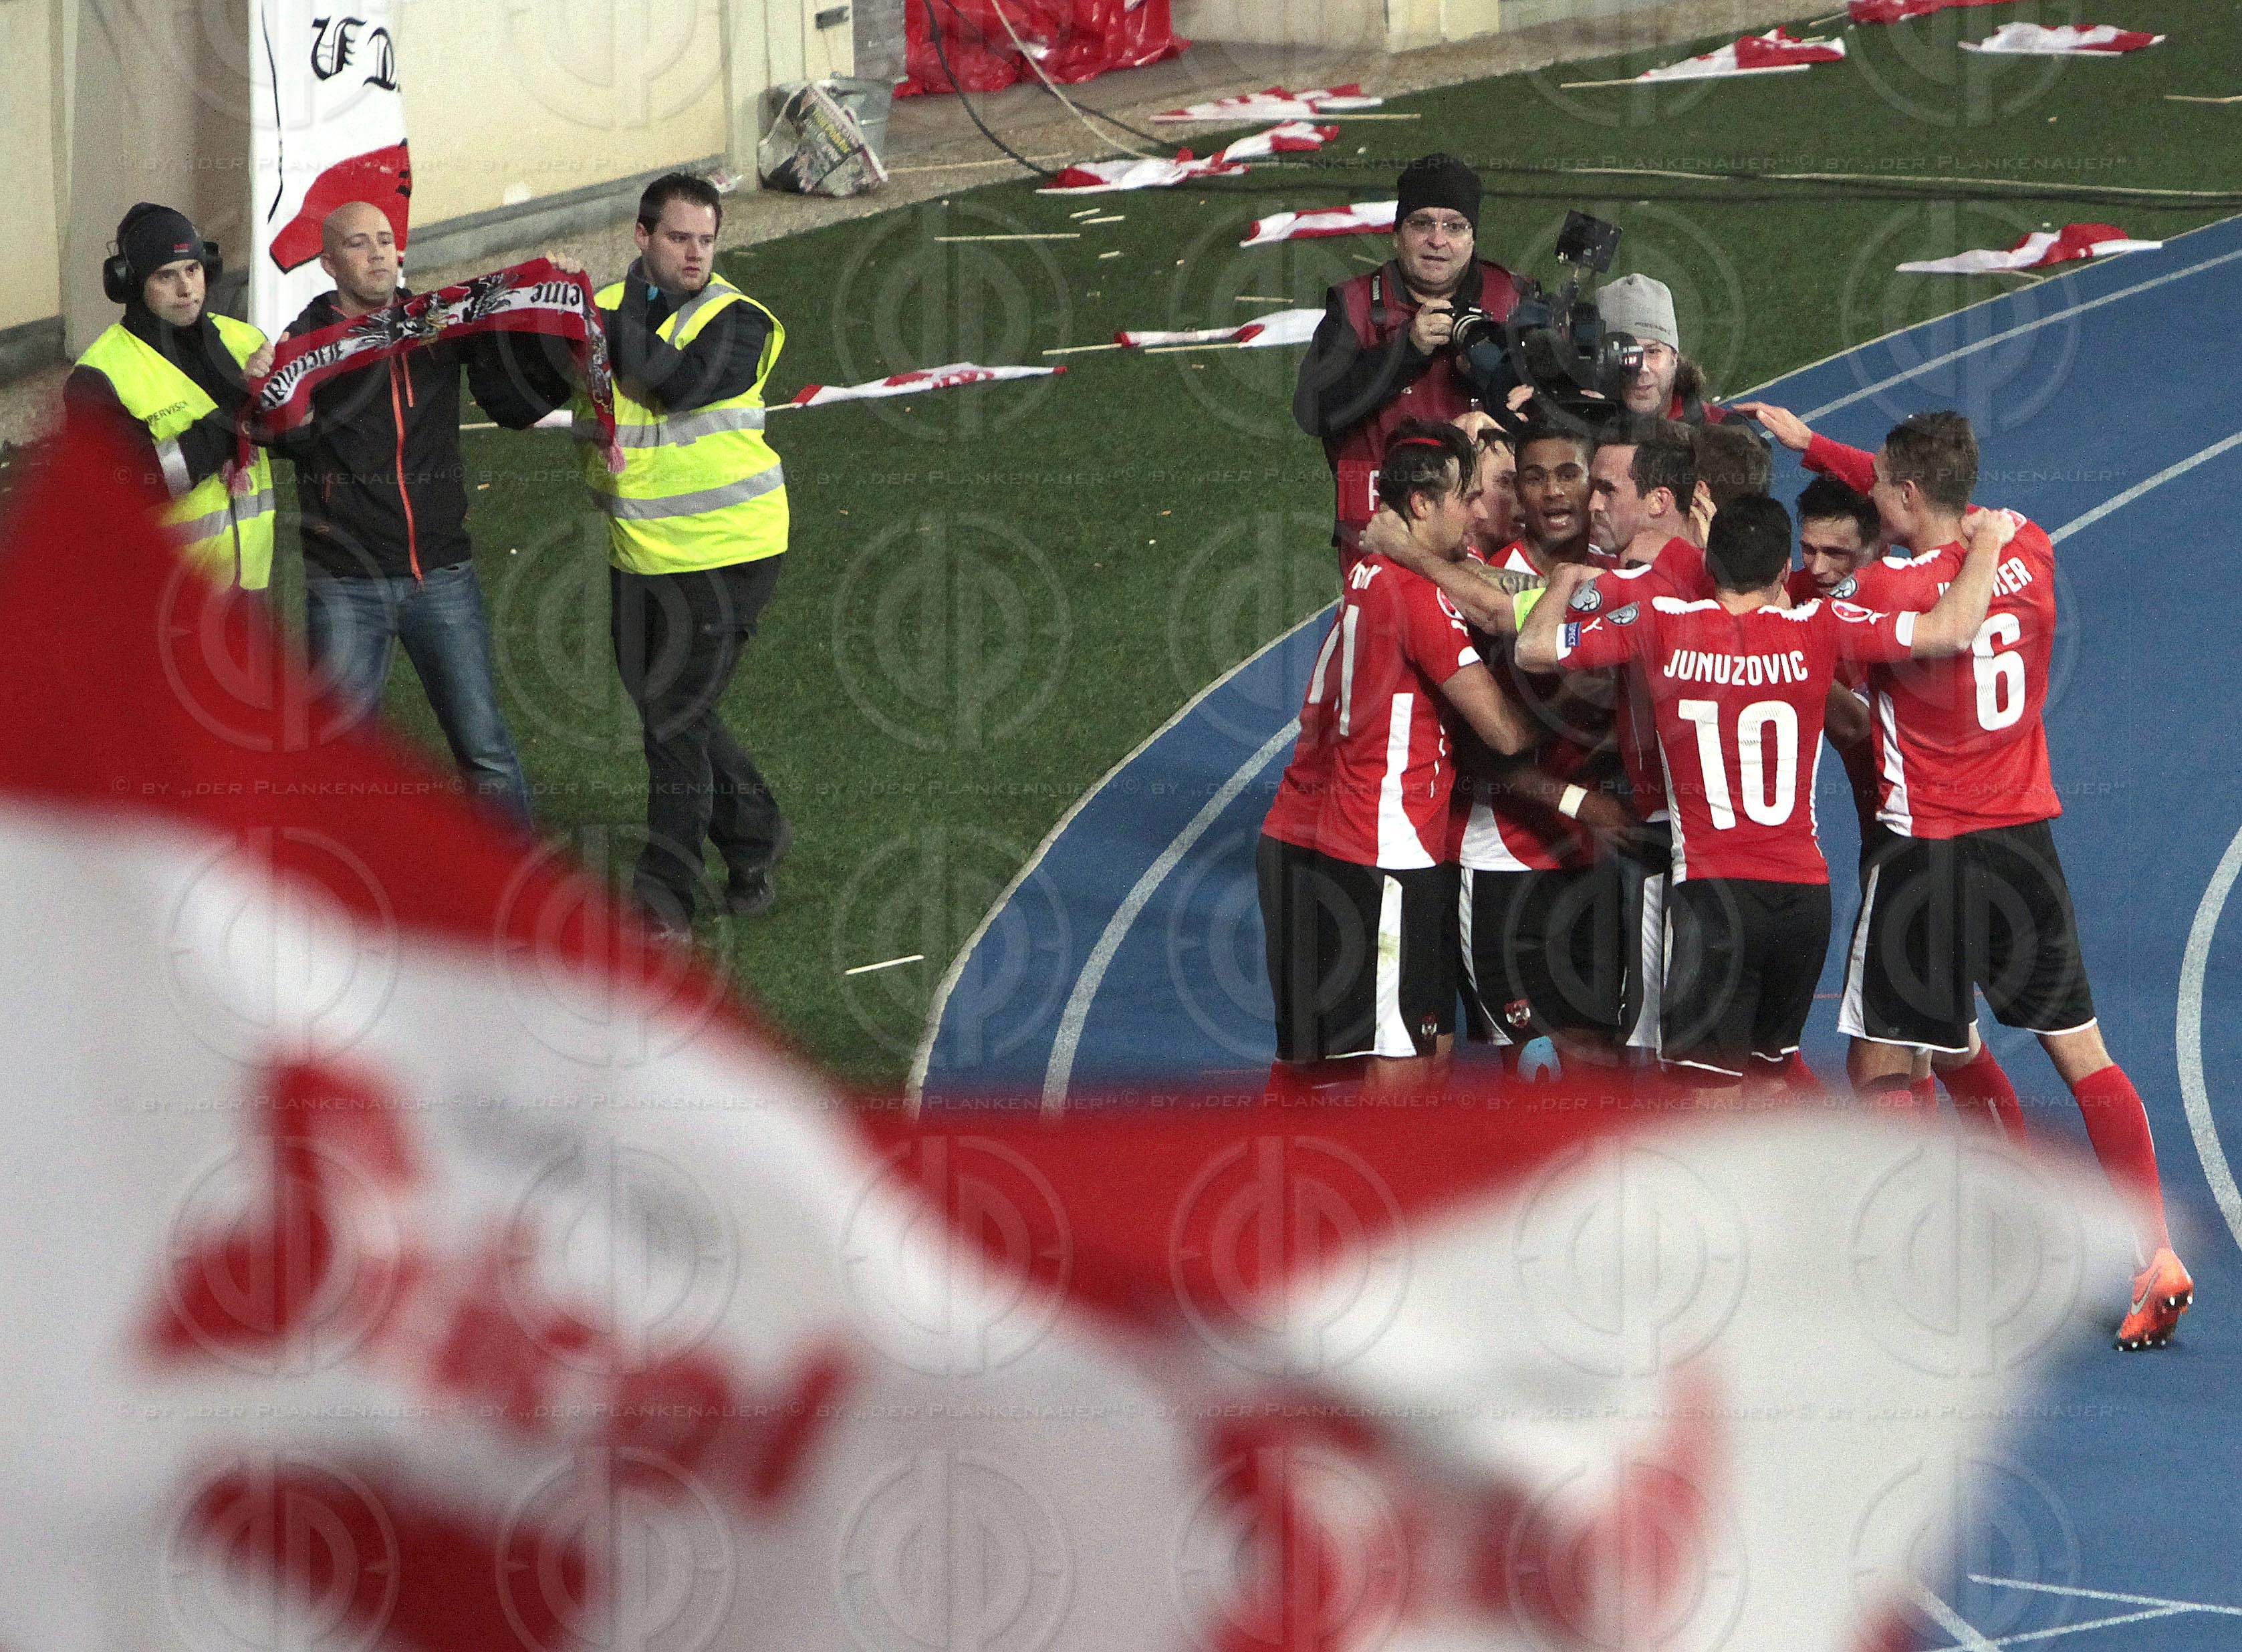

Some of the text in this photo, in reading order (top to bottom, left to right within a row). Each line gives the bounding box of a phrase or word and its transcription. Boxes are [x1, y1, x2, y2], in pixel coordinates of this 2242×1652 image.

[1663, 648, 1808, 686] JUNUZOVIC
[1971, 612, 2025, 731] 6
[1678, 699, 1799, 830] 10
